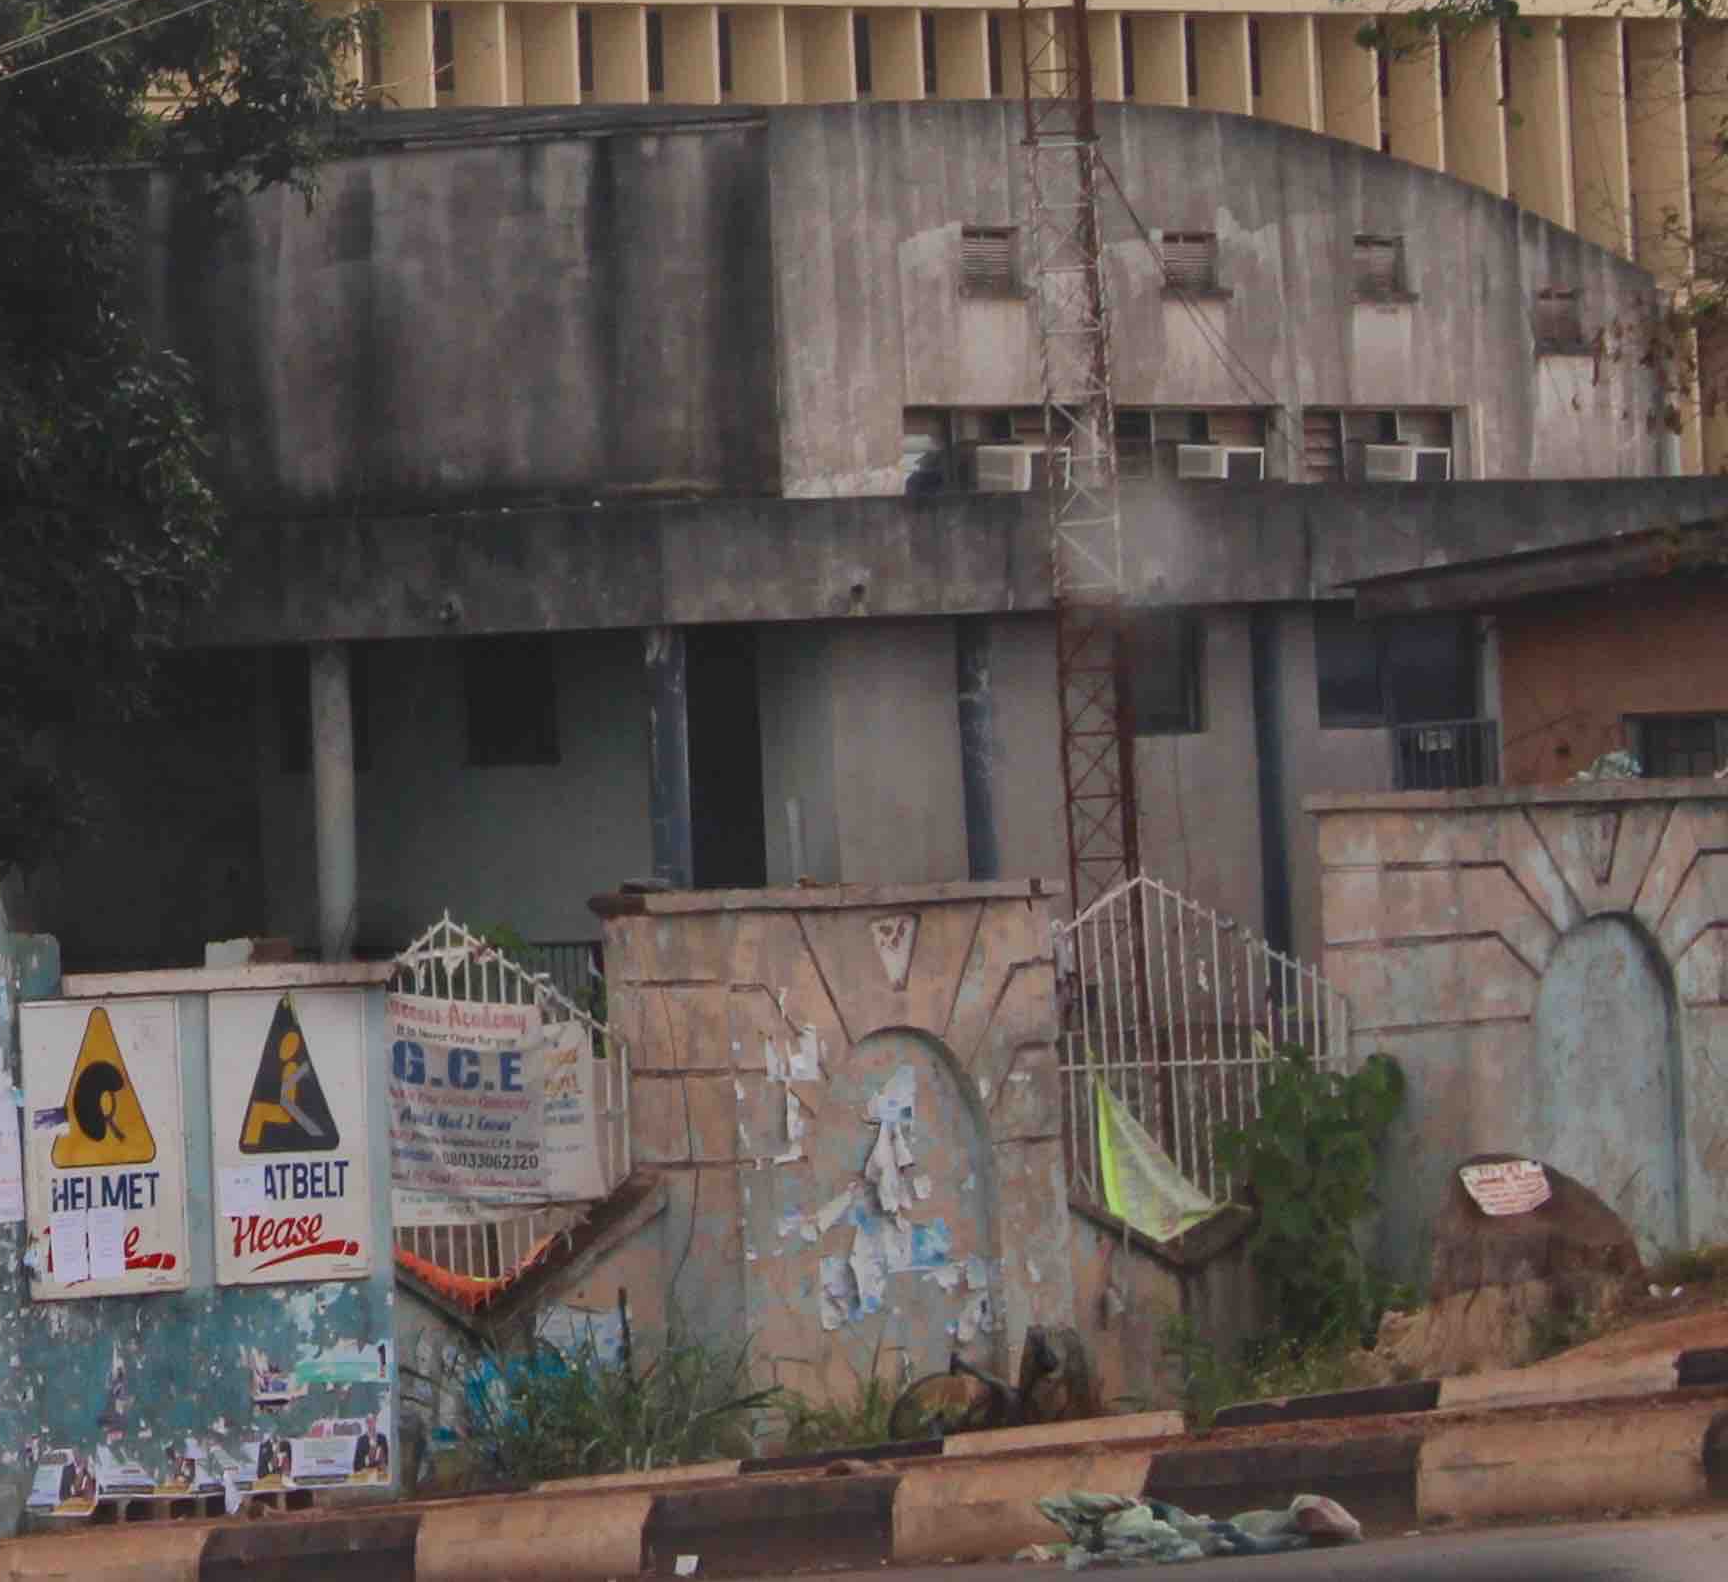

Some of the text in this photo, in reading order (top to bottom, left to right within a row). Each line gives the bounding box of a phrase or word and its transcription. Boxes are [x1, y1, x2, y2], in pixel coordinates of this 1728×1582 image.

[392, 1039, 524, 1092] G.C.E
[51, 1171, 161, 1212] HELMET
[263, 1160, 350, 1201] ATBELT
